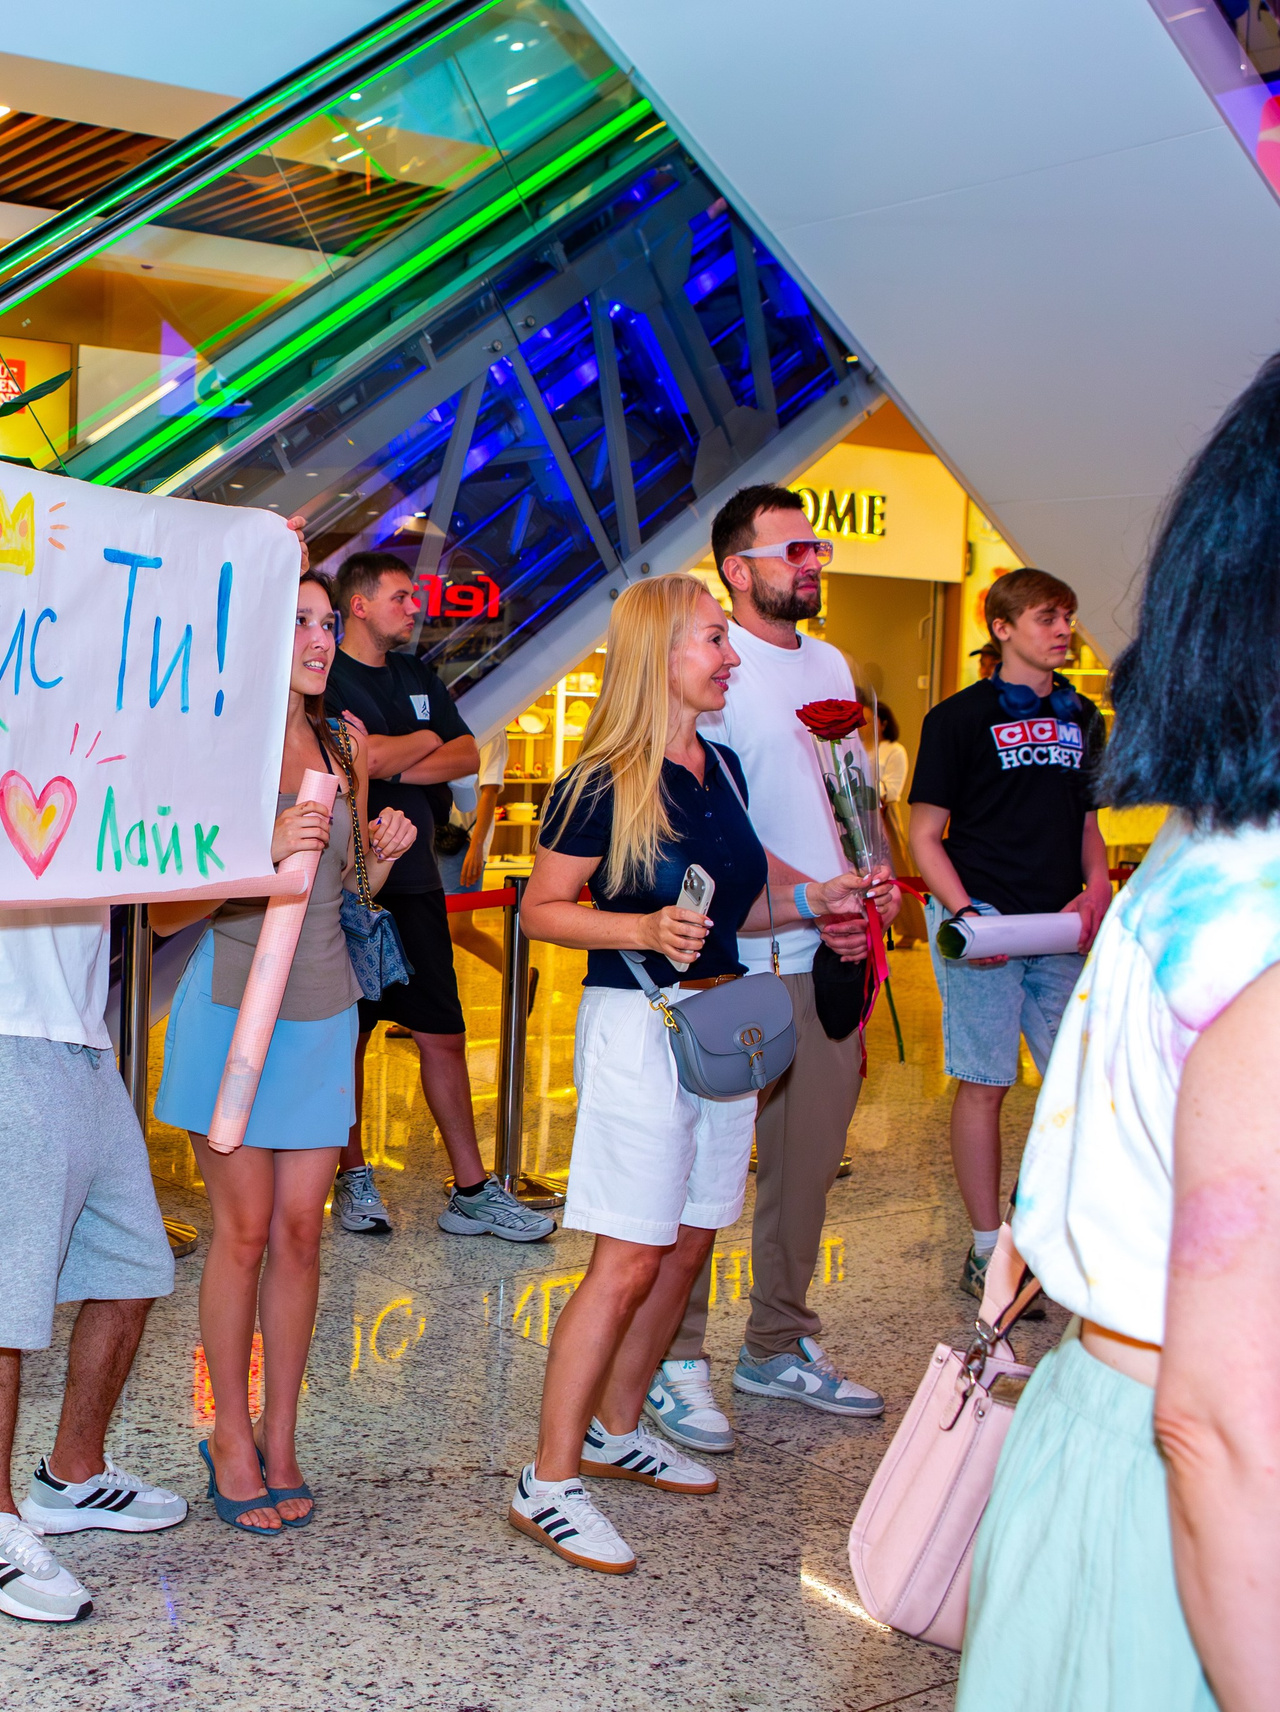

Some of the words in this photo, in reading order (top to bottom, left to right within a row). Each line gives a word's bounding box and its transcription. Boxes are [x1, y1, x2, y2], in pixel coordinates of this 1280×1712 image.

[797, 487, 886, 536] OME
[997, 721, 1081, 745] CCM
[997, 745, 1084, 770] HOCKEY
